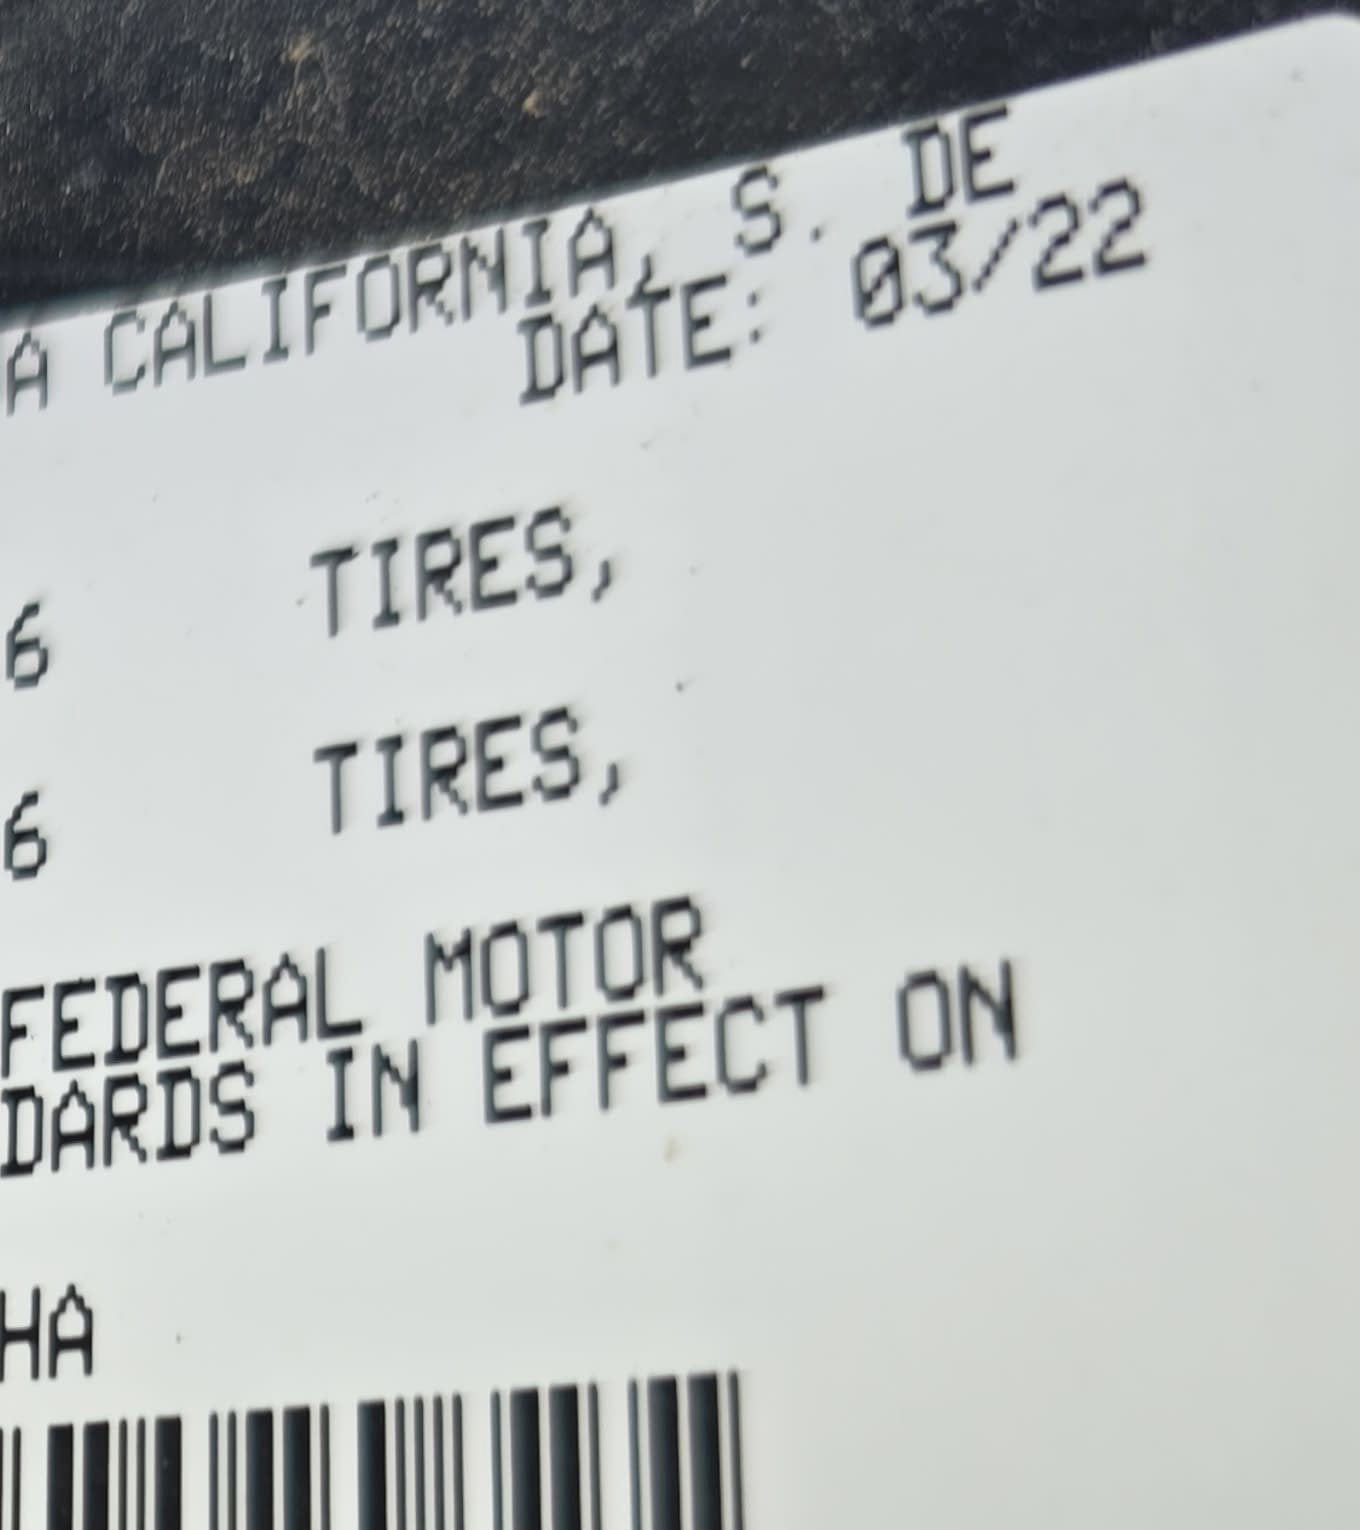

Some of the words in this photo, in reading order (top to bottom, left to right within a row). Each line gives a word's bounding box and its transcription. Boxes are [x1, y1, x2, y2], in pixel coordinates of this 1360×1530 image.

[105, 208, 653, 394] CALIFORNIA,
[734, 166, 825, 254] S.
[902, 105, 1014, 217] DE
[519, 271, 765, 404] DATE:
[853, 177, 1148, 328] 03/22
[310, 506, 612, 637] TIRES,
[314, 706, 619, 834] TIRES,
[2, 947, 362, 1078] FEDERAL
[425, 896, 703, 1026] MOTOR
[327, 1039, 420, 1142] IN
[484, 985, 826, 1125] EFFECT
[896, 957, 1017, 1074] ON
